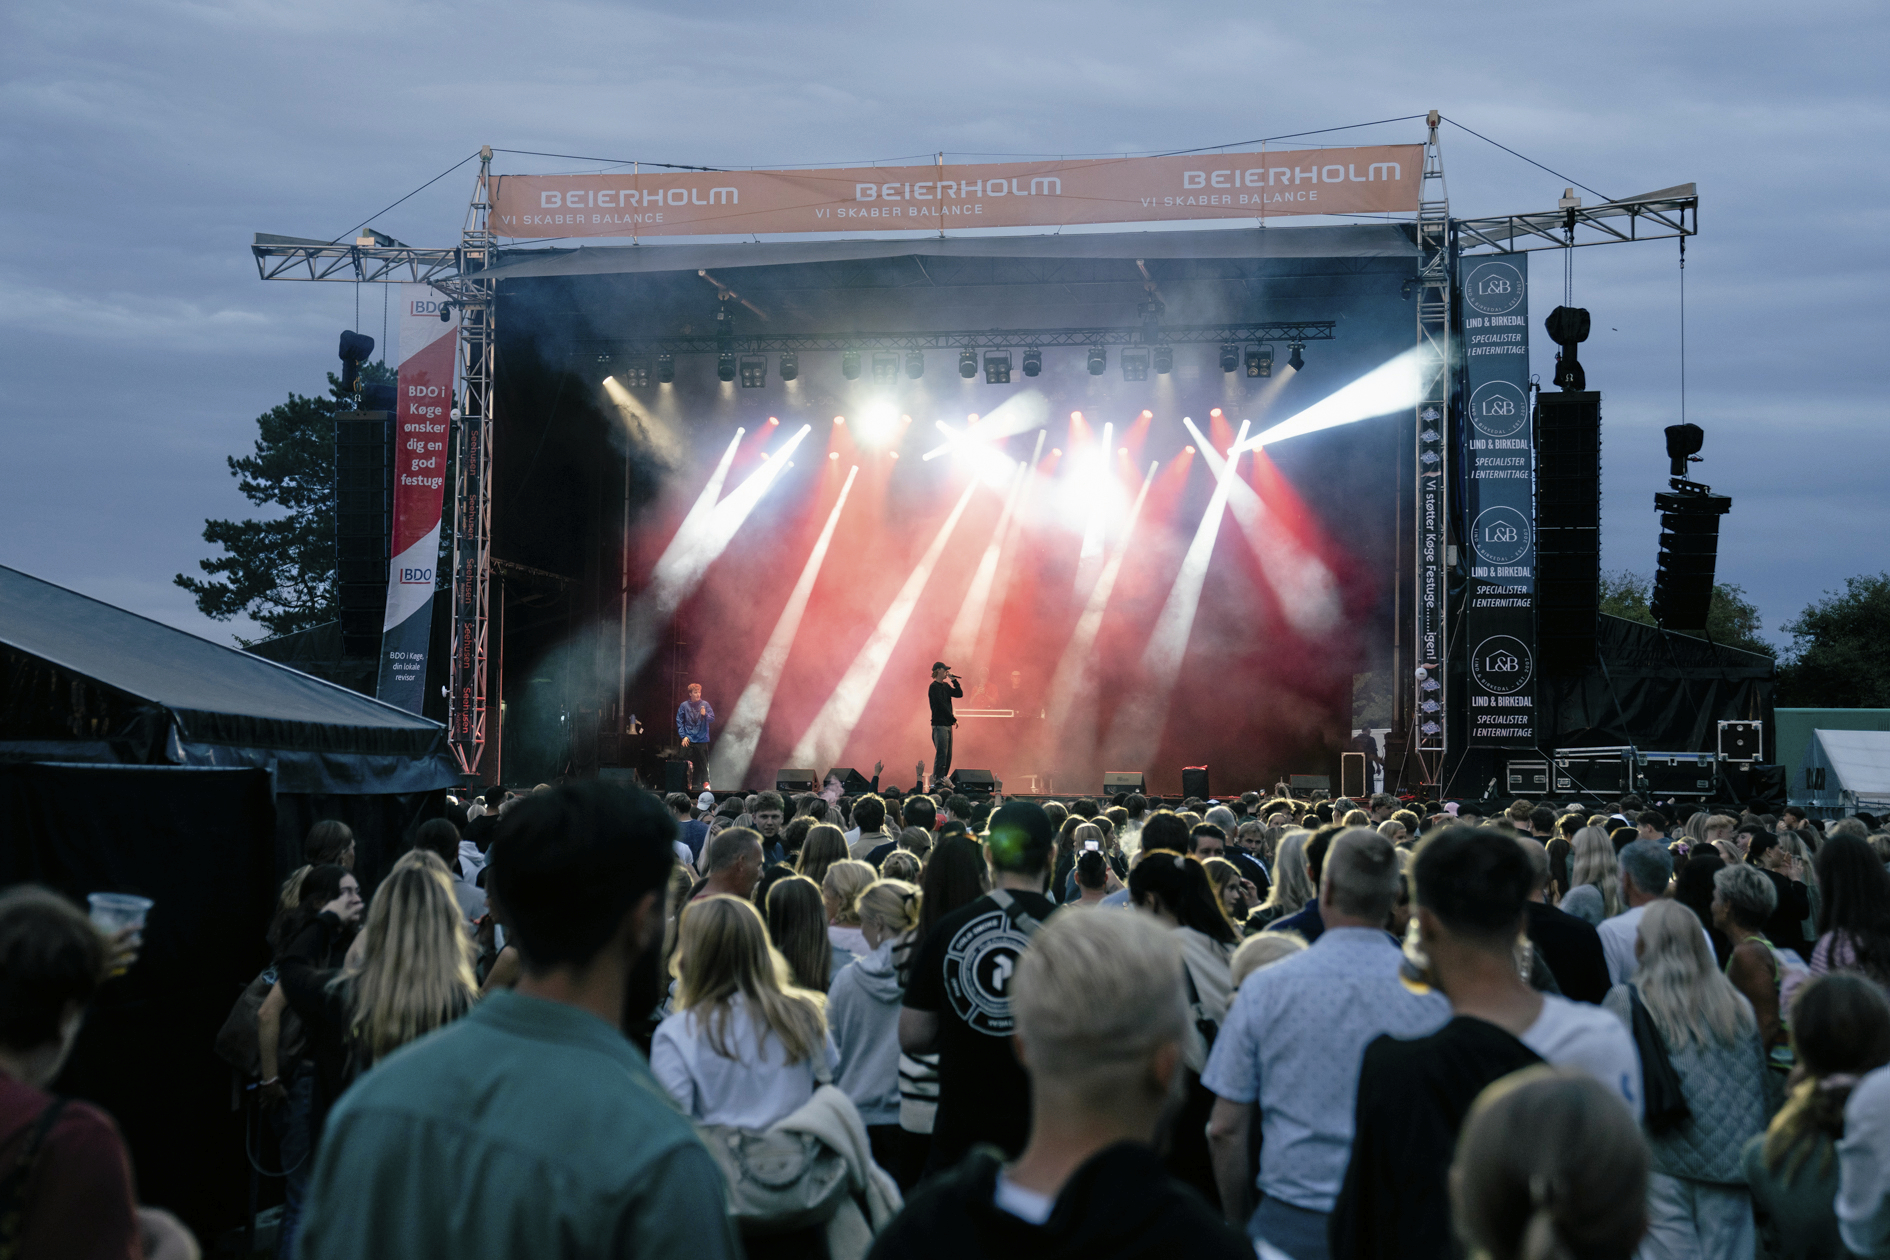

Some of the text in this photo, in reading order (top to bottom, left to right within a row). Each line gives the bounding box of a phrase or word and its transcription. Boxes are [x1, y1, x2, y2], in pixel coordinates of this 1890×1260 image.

[1183, 162, 1401, 189] BEIERHOLM
[855, 177, 1062, 201] BEIERHOLM
[540, 187, 739, 208] BEIERHOLM
[1141, 190, 1318, 207] VI SKABER BALANCE
[815, 204, 983, 218] VI SKABER BALANCE
[501, 213, 664, 225] VI SKABER BALANCE
[1479, 280, 1511, 295] L&B
[1466, 316, 1525, 328] LIND & BIRKEDAL
[1471, 334, 1521, 343] SPECIALISTER
[1472, 346, 1525, 356] ENTERNITTAGE
[408, 386, 445, 397] BDO i
[410, 403, 442, 418] Køge
[1483, 401, 1515, 415] L&B
[404, 422, 445, 432] ønsker
[406, 438, 442, 452] dig en
[1470, 439, 1528, 449] LIND & BIRKEDAL
[470, 430, 478, 476] Seehusen
[412, 457, 435, 470] god
[1475, 458, 1524, 466] SPECIALISTER
[1476, 470, 1528, 478] ENTERNITTAGE
[401, 474, 442, 489] festuge
[1426, 481, 1436, 490] Vi
[468, 494, 476, 540] Seehusen
[1426, 494, 1435, 530] støtter
[1486, 528, 1517, 542] L&B
[1424, 534, 1436, 562] Køge
[404, 568, 431, 581] BDO
[1472, 567, 1531, 577] LIND & BIRKEDAL
[466, 558, 474, 604] Seehusen
[1476, 586, 1527, 594] SPECIALISTER
[1477, 599, 1531, 607] ENTERNITTAGE
[464, 623, 472, 669] Seehusen
[1486, 657, 1518, 672] L&B
[1472, 696, 1532, 706] LIND & BIRKEDAL
[462, 688, 471, 733] Seehusen
[1477, 716, 1528, 724] SPECIALISTER
[1477, 728, 1532, 736] ENTERNITTAGE
